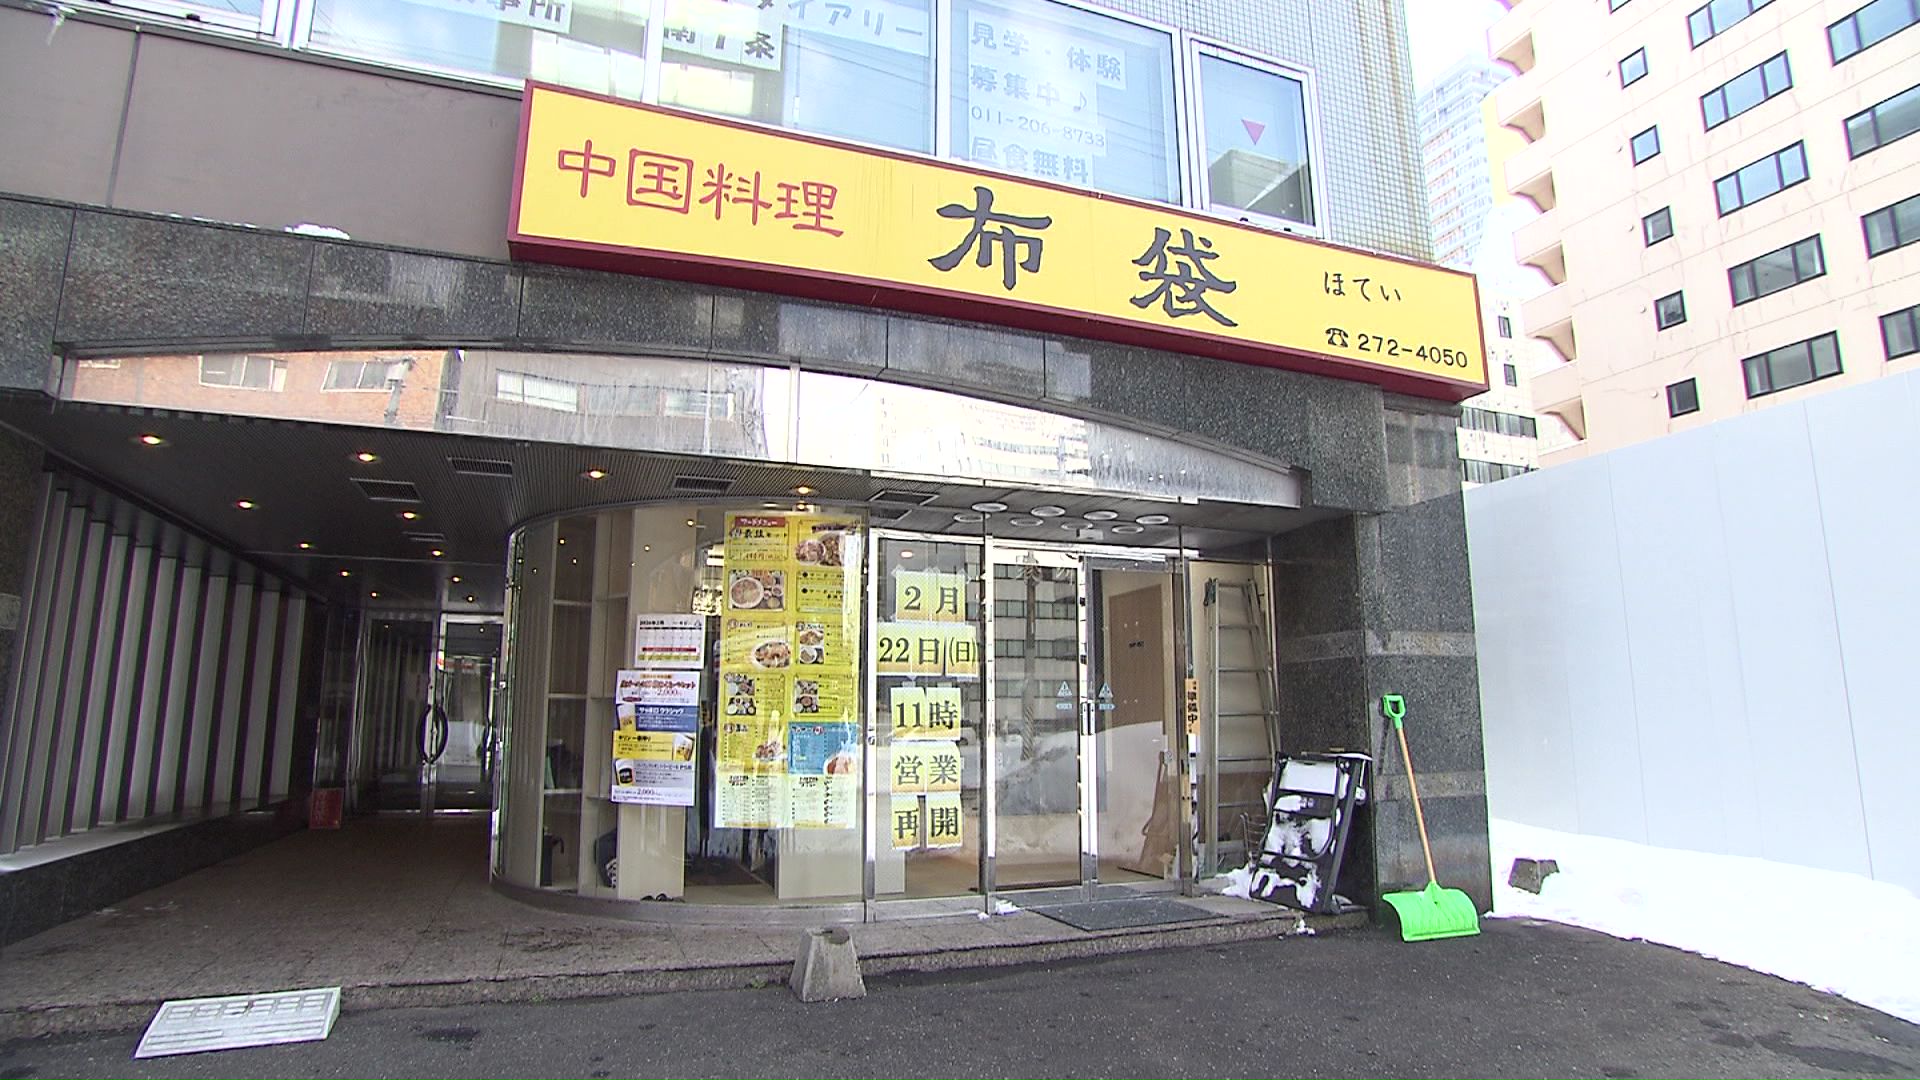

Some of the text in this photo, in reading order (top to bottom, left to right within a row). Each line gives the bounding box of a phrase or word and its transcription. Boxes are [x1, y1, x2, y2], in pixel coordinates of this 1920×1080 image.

[971, 105, 1105, 147] 011-206-8733
[558, 139, 1239, 327] 中国料理 布袋
[1324, 271, 1401, 302] ほてい
[903, 585, 959, 615] 2月
[896, 700, 958, 730] 11時
[895, 754, 958, 786] 営業
[894, 806, 959, 839] 再開
